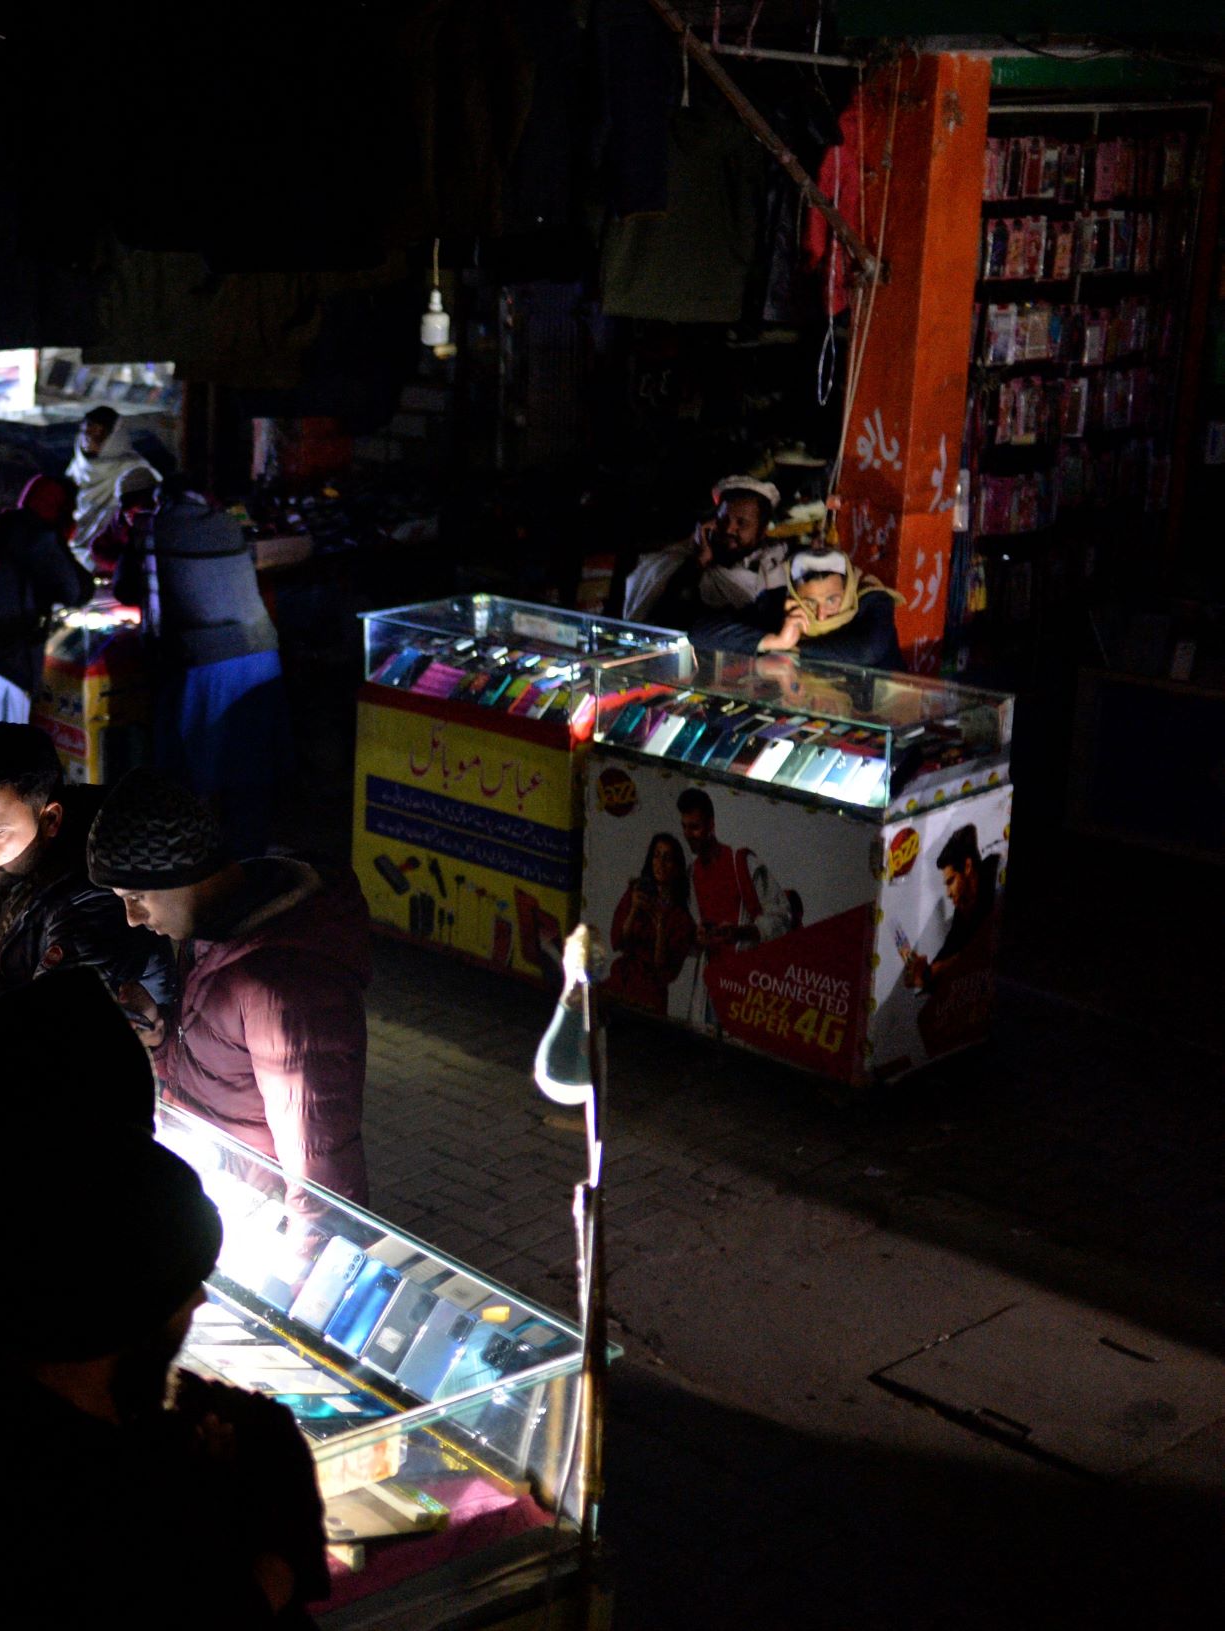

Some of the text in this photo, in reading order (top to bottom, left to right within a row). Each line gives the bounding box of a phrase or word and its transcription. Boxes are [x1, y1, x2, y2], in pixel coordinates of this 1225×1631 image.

[479, 758, 543, 812] عباس
[718, 976, 792, 1019] WITH JAZZ
[747, 969, 850, 1017] CONNECTED
[783, 963, 851, 1000] ALWAYS
[727, 1000, 848, 1054] SUPER 4G
